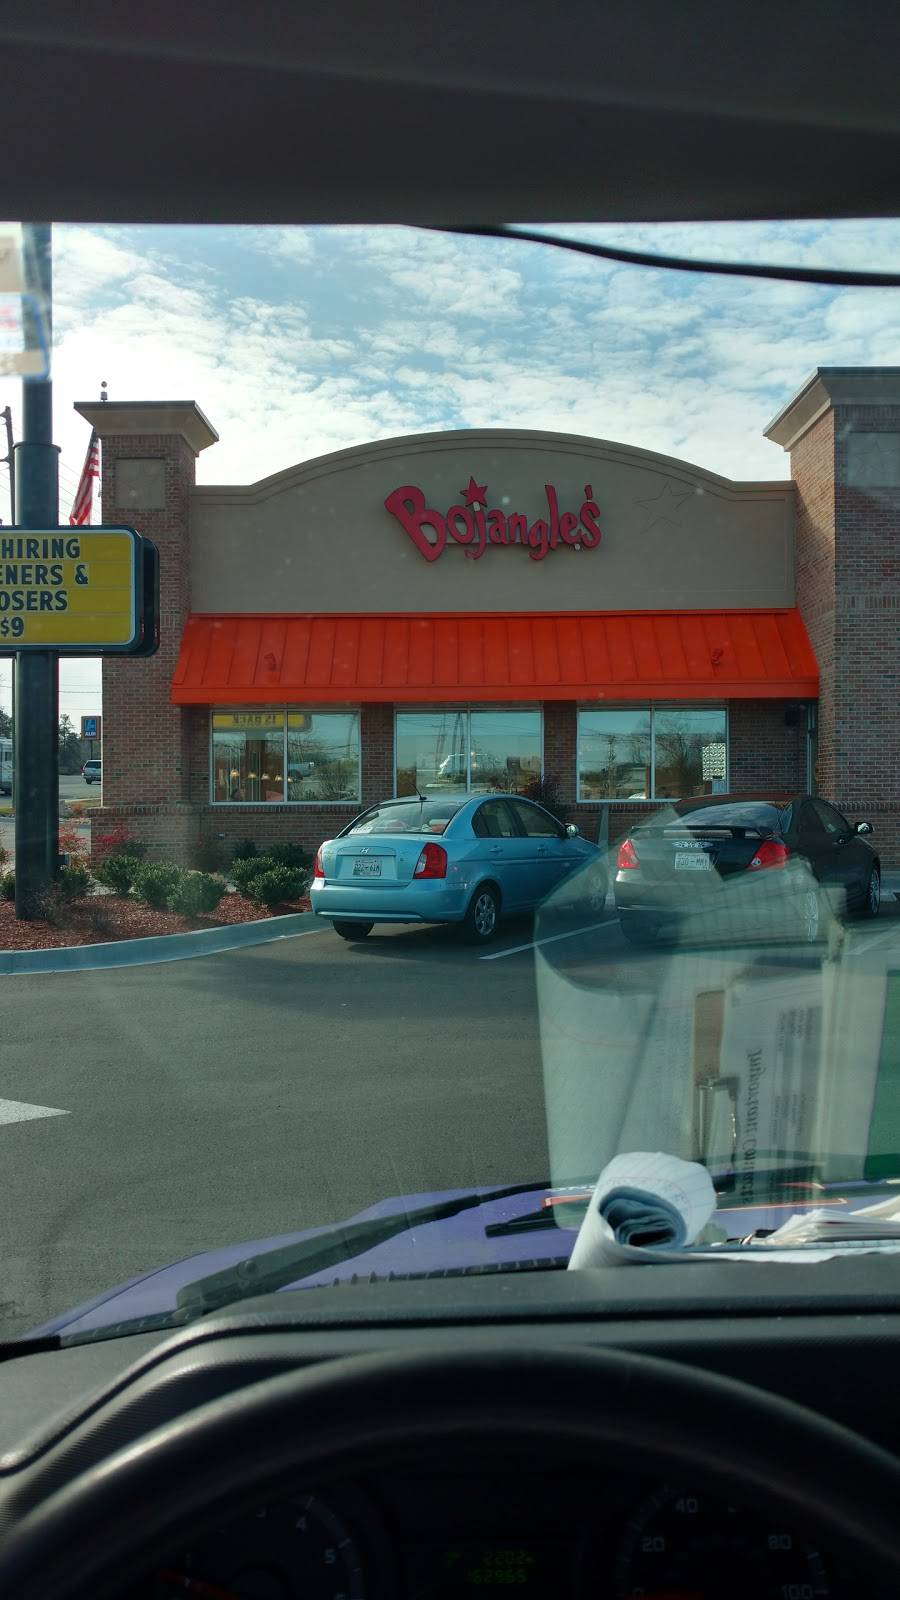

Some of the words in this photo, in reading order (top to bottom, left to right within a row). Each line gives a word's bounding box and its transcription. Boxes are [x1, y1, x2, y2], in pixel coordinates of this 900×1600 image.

[1, 538, 80, 559] HIRING
[75, 565, 89, 585] &
[0, 591, 68, 611] OSERS
[1, 617, 24, 637] $9
[674, 1498, 698, 1513] 40
[640, 1536, 665, 1551] 20
[324, 1548, 336, 1564] 5
[782, 1583, 814, 1600] 100
